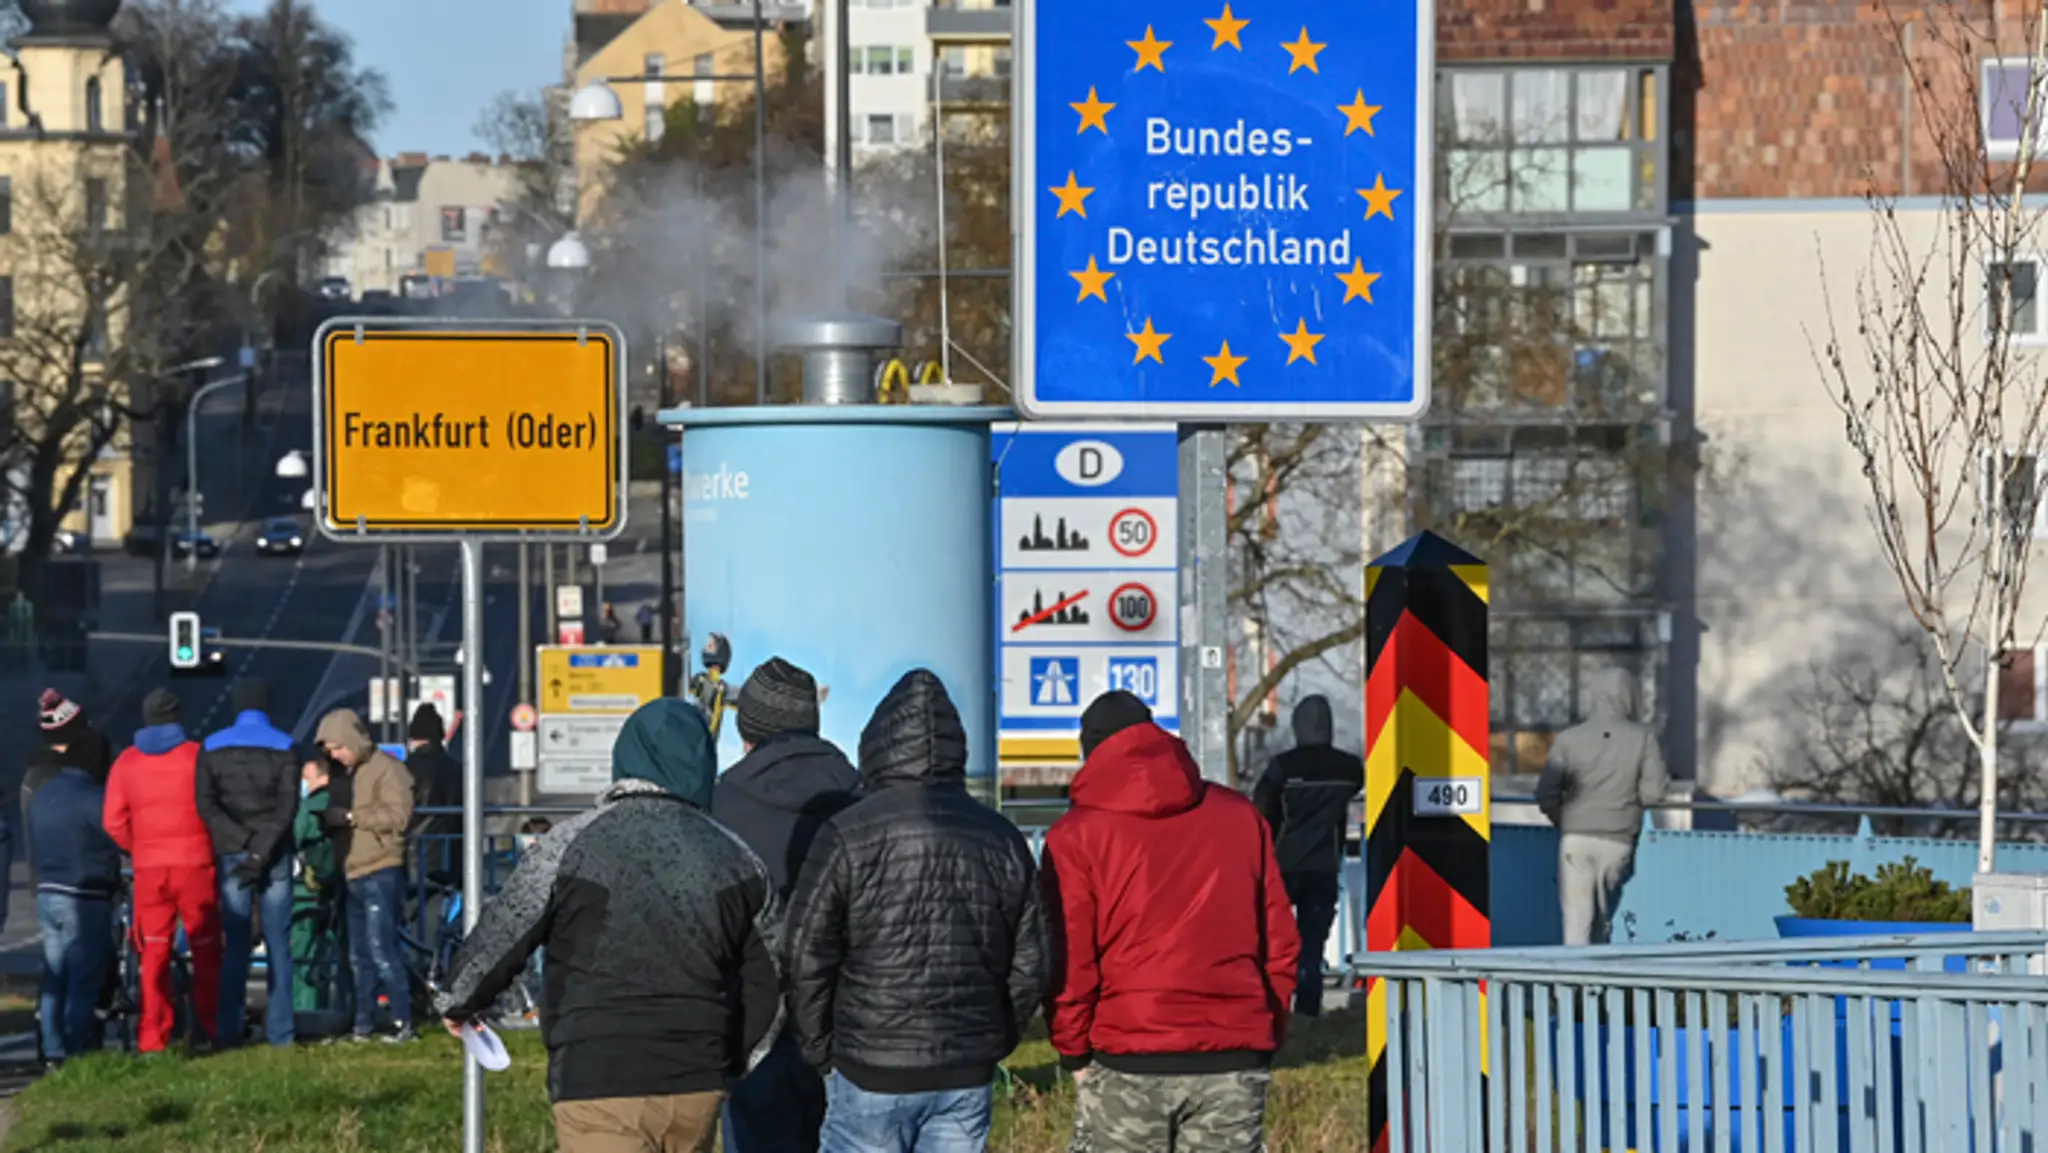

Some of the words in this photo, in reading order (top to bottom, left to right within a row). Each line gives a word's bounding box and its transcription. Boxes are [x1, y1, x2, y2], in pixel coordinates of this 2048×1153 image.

[1146, 117, 1312, 156] Bundes-
[1148, 173, 1310, 219] republik
[1107, 227, 1351, 265] Deutschland
[344, 411, 489, 449] Frankfurt
[505, 410, 598, 451] (Oder)
[1079, 447, 1104, 480] D
[1119, 520, 1148, 545] 50
[1118, 595, 1149, 619] 100
[1111, 663, 1155, 699] 130
[1427, 784, 1468, 806] 490
